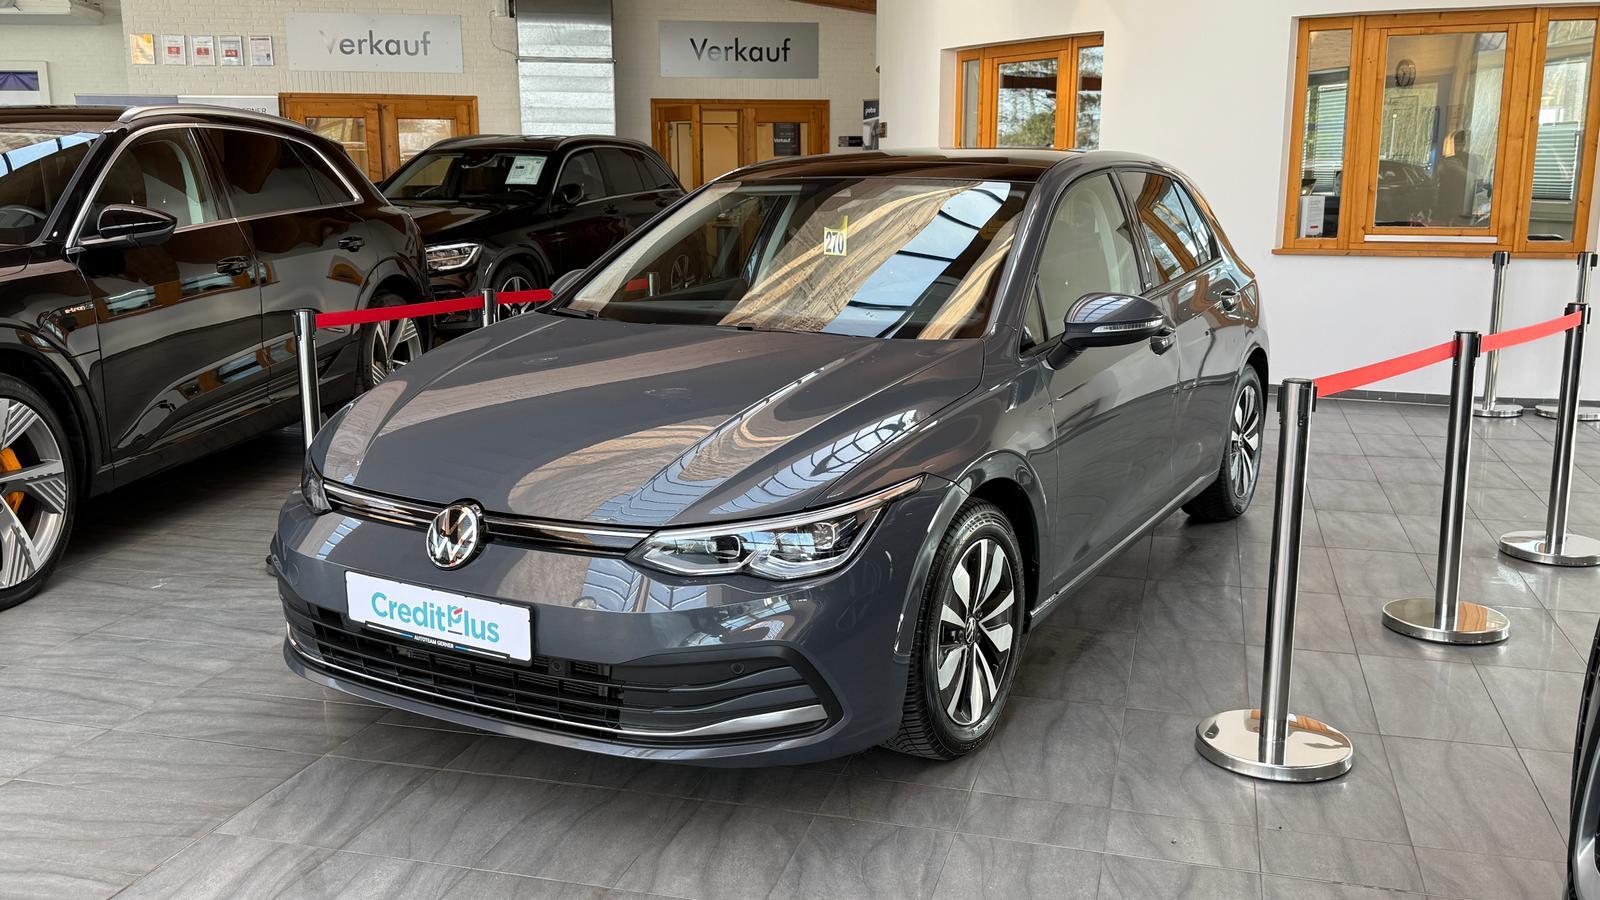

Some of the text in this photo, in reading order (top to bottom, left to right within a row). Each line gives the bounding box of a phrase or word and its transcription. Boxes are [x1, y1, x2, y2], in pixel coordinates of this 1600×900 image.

[689, 37, 791, 62] Verkauf
[825, 231, 845, 254] 270
[371, 591, 500, 643] CreditPlus
[413, 635, 437, 645] AUTOTEAM
